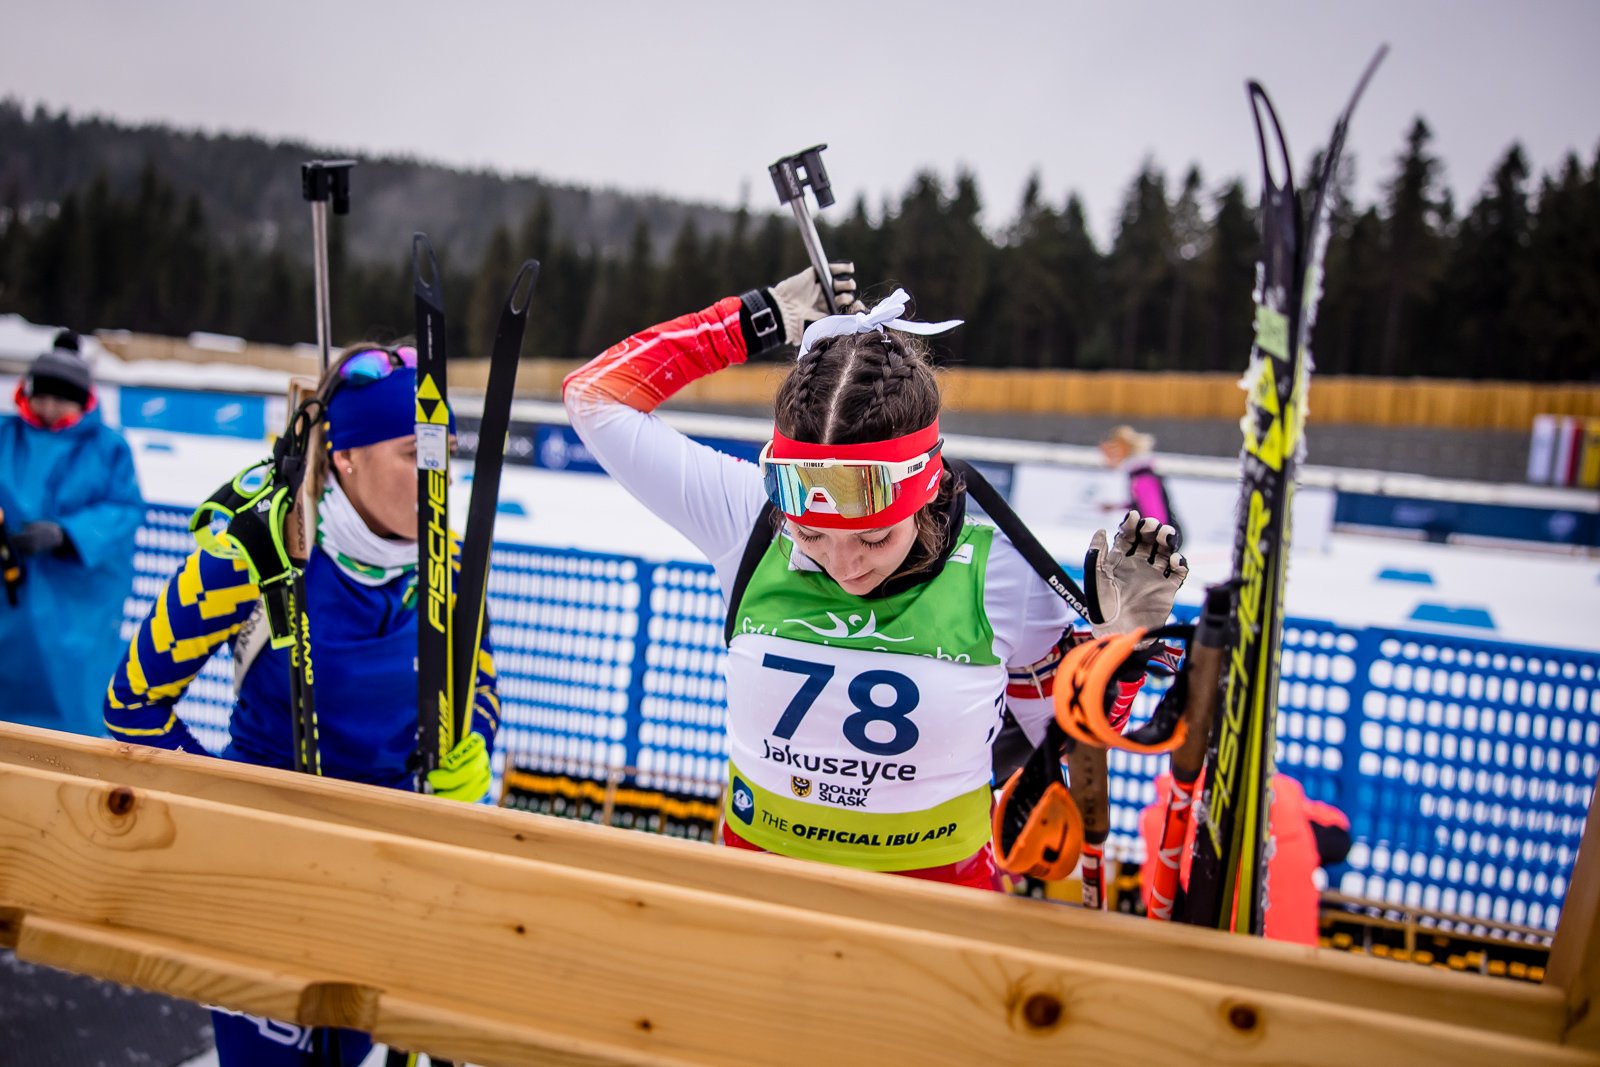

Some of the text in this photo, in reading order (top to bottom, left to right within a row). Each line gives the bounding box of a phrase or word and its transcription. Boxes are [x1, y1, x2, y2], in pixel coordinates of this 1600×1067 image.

[428, 469, 446, 633] FISCHE
[762, 653, 920, 756] 78
[760, 739, 917, 785] Jakuszyce
[819, 782, 871, 797] DOLNY
[761, 810, 957, 846] THE OFFICIAL IBU APP
